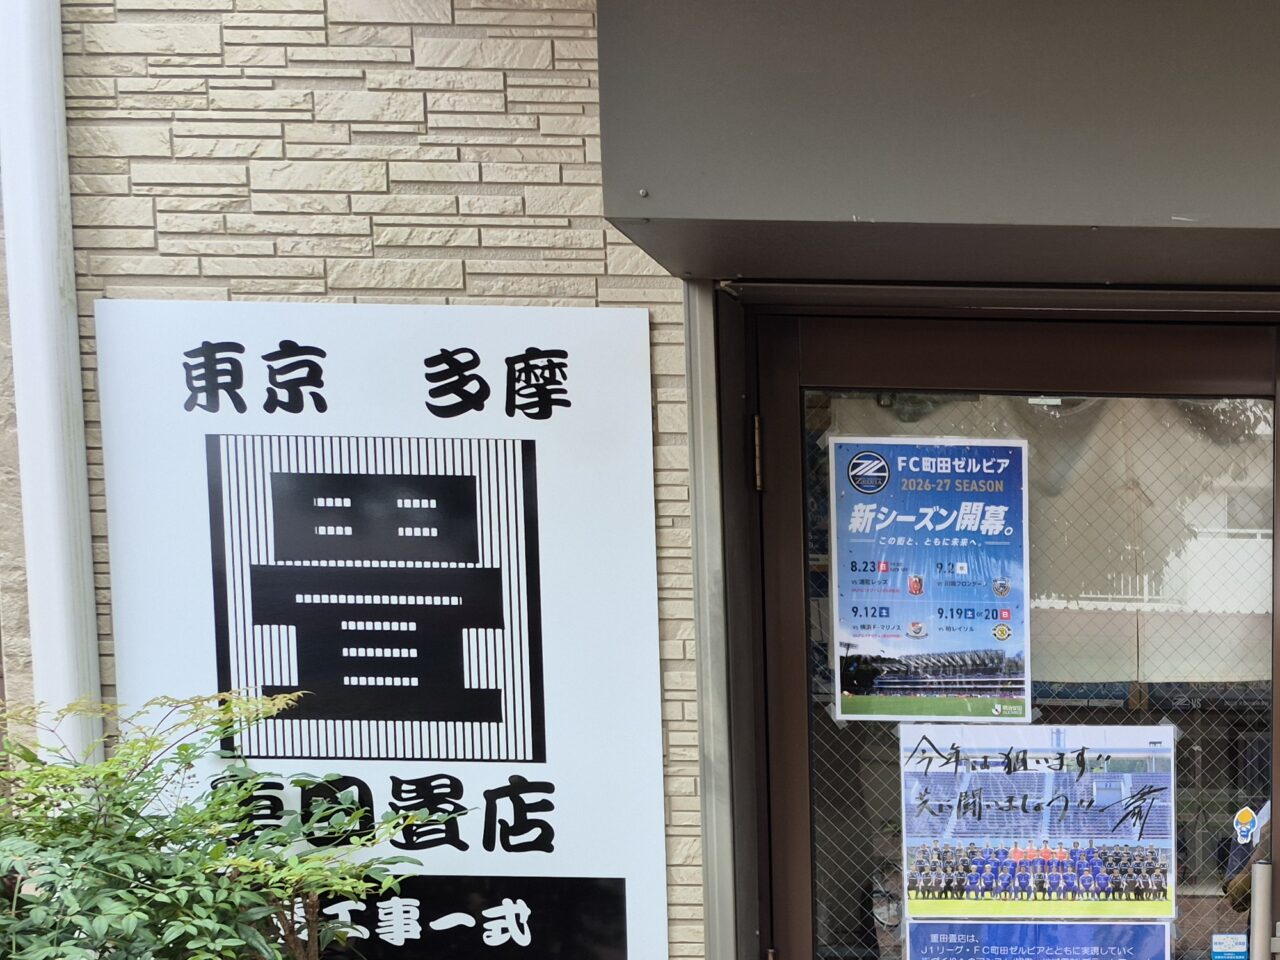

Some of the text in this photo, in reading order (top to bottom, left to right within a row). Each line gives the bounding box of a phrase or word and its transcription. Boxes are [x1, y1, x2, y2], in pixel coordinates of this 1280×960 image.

[183, 339, 573, 420] 東京 多摩
[897, 456, 1009, 474] FC町田ゼルビア
[901, 479, 1004, 492] 2026-27 SEASON
[848, 502, 1013, 535] 新シーズン開幕。
[851, 561, 876, 572] 8.23
[852, 607, 877, 618] 9.12
[938, 608, 963, 619] 9.19
[985, 610, 998, 620] 20
[277, 897, 531, 947] 工事一式
